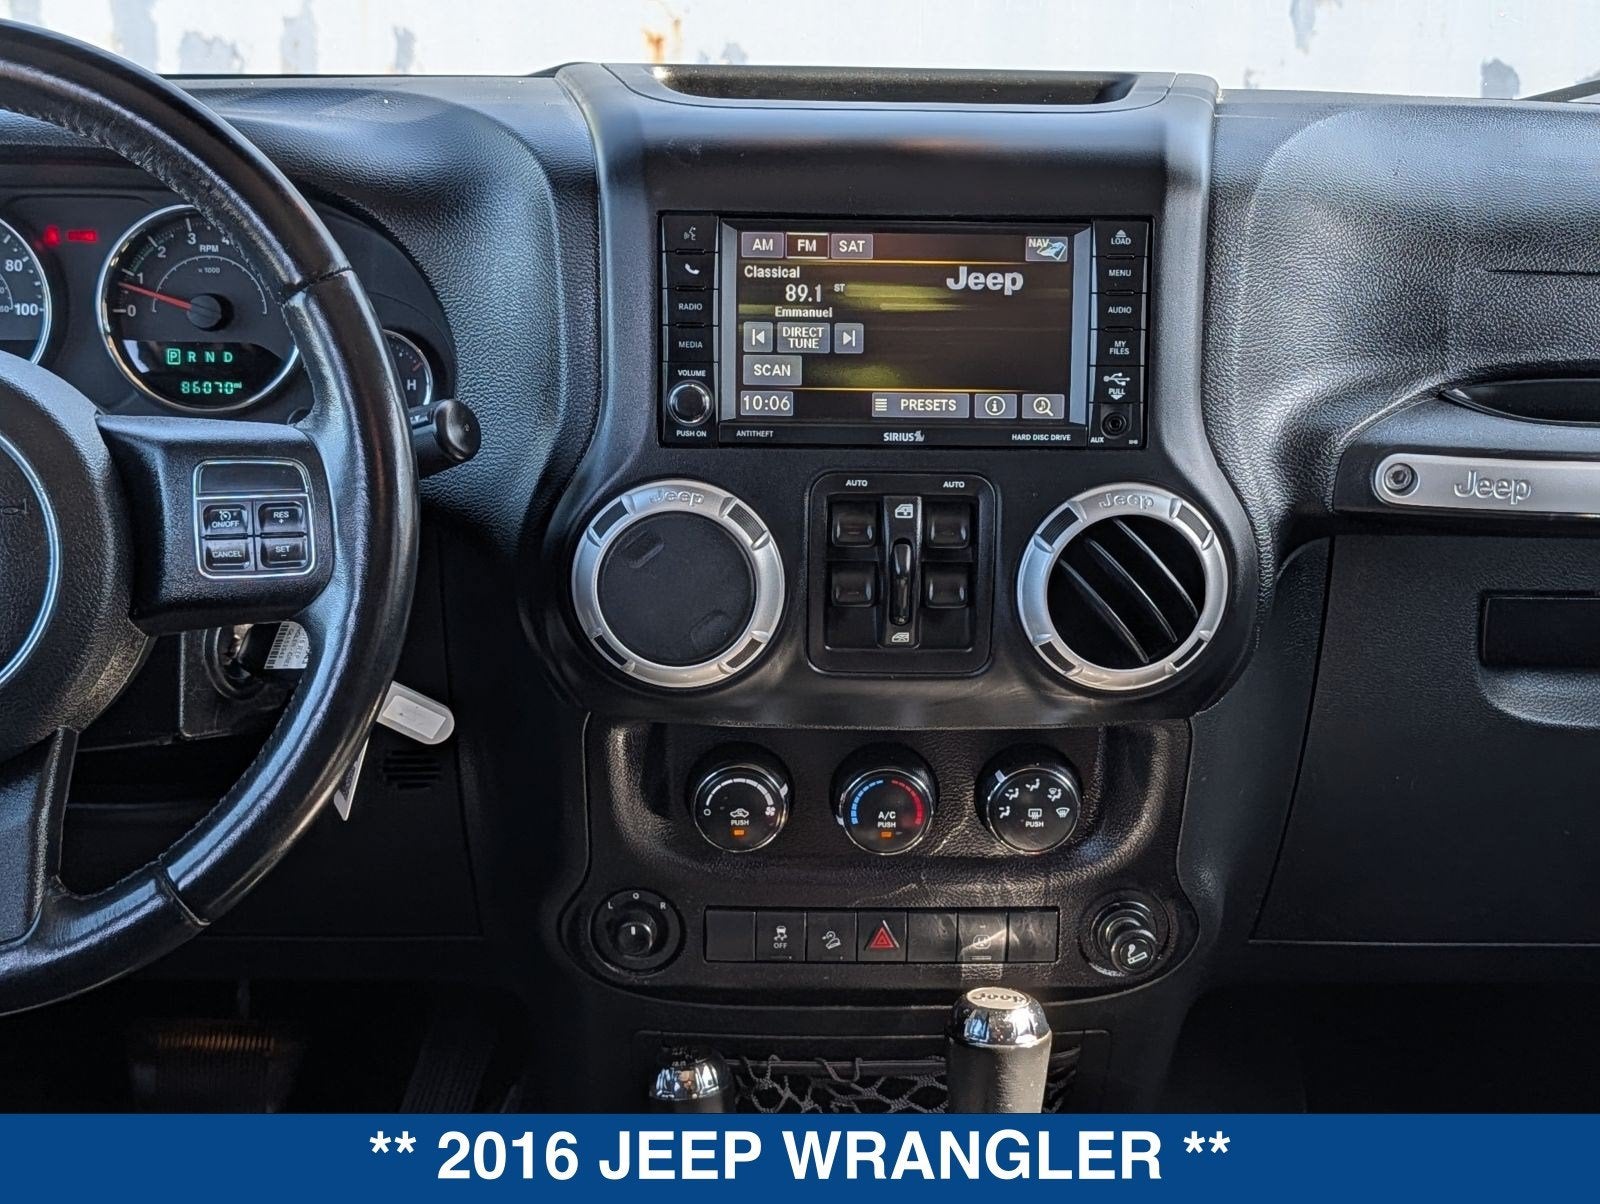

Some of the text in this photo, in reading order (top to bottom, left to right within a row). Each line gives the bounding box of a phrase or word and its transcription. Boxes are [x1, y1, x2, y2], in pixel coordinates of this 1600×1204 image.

[187, 232, 197, 245] 3
[1028, 238, 1050, 247] NAV
[1111, 237, 1131, 245] LOAD
[200, 244, 219, 253] RPM
[752, 238, 774, 251] AM
[797, 239, 816, 252] FM
[839, 240, 865, 253] SAT
[157, 246, 167, 258] 2
[5, 259, 23, 272] 80
[744, 265, 800, 278] Classical
[1108, 269, 1132, 277] MENU
[137, 272, 144, 284] 1
[946, 266, 1024, 296] Jeep
[785, 283, 846, 303] 89.1 ST
[14, 303, 39, 316] 100
[127, 304, 137, 317] 0
[678, 302, 703, 311] RADIO
[1108, 306, 1132, 314] AUDIO
[774, 306, 833, 318] Emmanuel
[782, 326, 824, 338] DIRECT
[678, 340, 703, 349] MEDIA
[788, 338, 820, 349] TUNE
[1114, 340, 1127, 348] MY
[1109, 347, 1130, 355] FILES
[170, 351, 233, 363] P R N D
[678, 369, 706, 377] VOLUME
[753, 364, 791, 377] SCAN
[406, 379, 417, 391] H
[1108, 387, 1126, 395] PULL
[743, 395, 791, 411] 10:06
[900, 398, 957, 412] PRESETS
[676, 429, 707, 437] PUSH ON
[736, 430, 774, 438] ANTITHEFT
[883, 432, 914, 442] SIRIUS
[1012, 433, 1071, 441] HARD DISC DRIVE
[1090, 436, 1104, 444] AUX
[845, 479, 868, 487] AUTO
[943, 480, 965, 488] AUTO
[1453, 470, 1532, 505] Jeep
[649, 488, 705, 507] Jeep
[1098, 492, 1154, 510] Jeep
[273, 511, 290, 519] RES
[211, 520, 240, 529] ON/OFF
[212, 550, 242, 559] CANCEL
[878, 811, 896, 820] A/C
[607, 901, 614, 909] L
[659, 901, 667, 909] R
